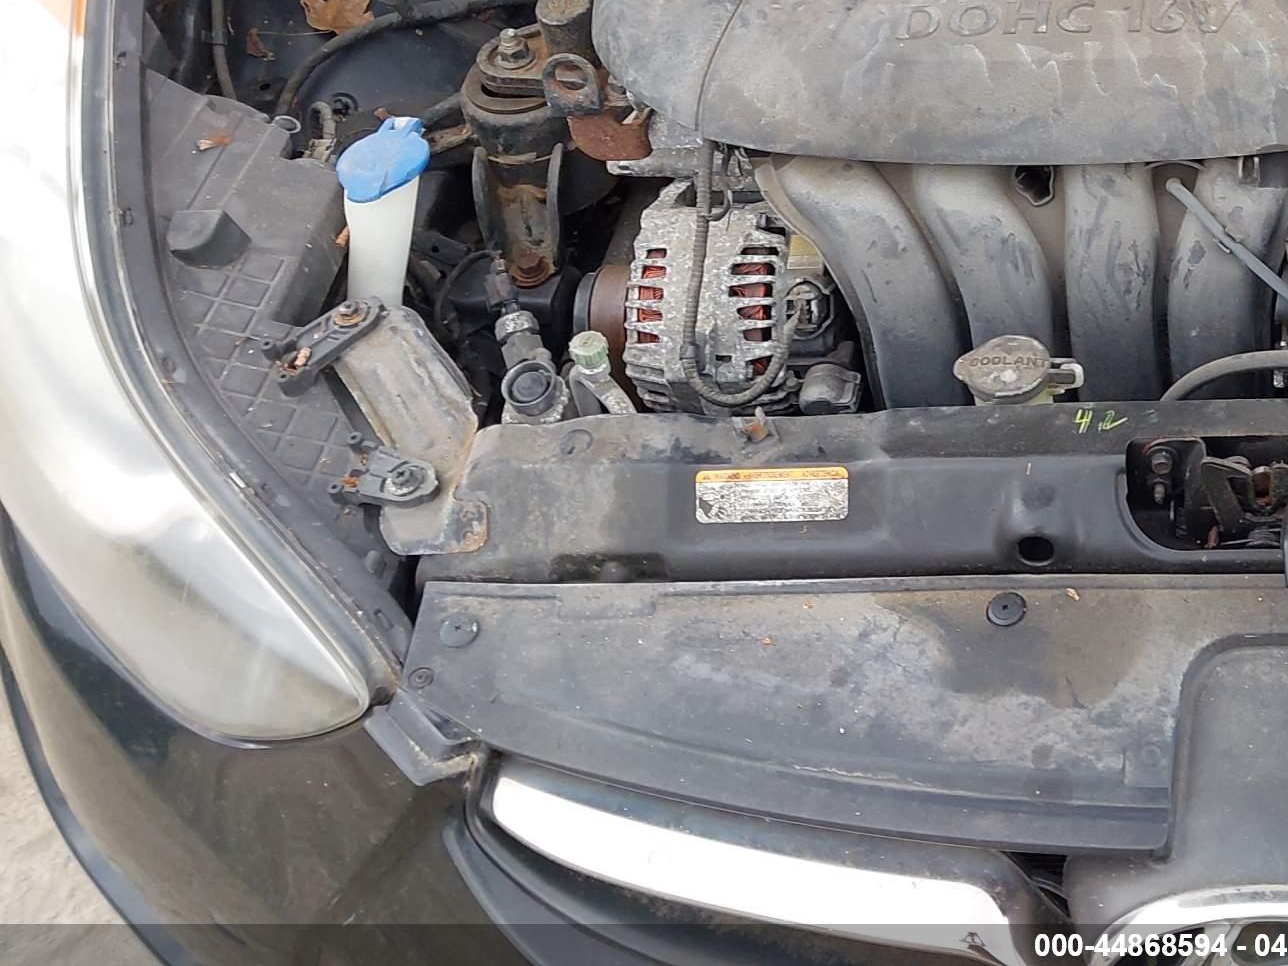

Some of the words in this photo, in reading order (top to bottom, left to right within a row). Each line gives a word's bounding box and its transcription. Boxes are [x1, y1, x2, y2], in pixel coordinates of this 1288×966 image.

[896, 0, 1096, 40] DOHC
[1122, 0, 1240, 35] 16V
[969, 355, 1049, 370] COOLANT
